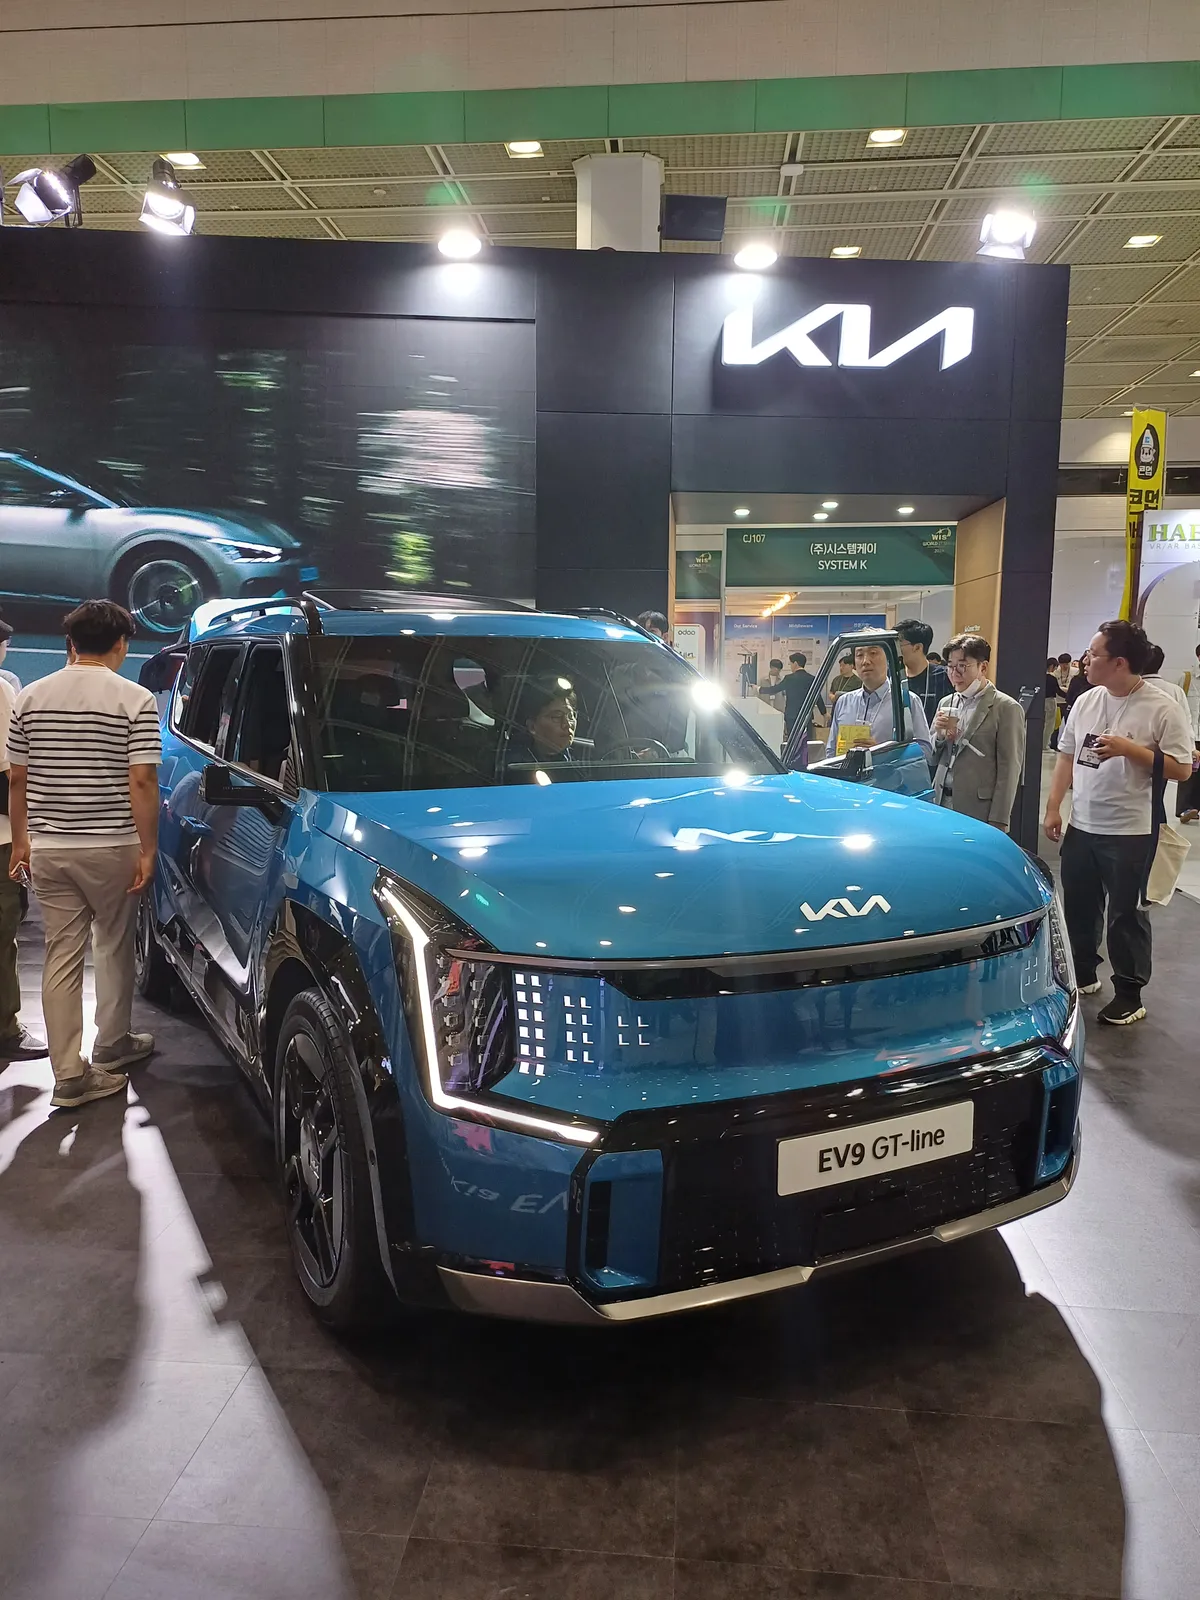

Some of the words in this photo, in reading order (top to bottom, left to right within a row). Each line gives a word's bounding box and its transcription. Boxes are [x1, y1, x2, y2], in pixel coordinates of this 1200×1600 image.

[722, 303, 975, 372] KIA
[743, 534, 766, 543] CJ107
[931, 533, 947, 541] WIS
[810, 543, 877, 555] (주)시스템케이
[818, 560, 857, 570] SYSTEM
[860, 560, 868, 569] K
[818, 1142, 865, 1173] EV9
[872, 1128, 945, 1160] GT-line
